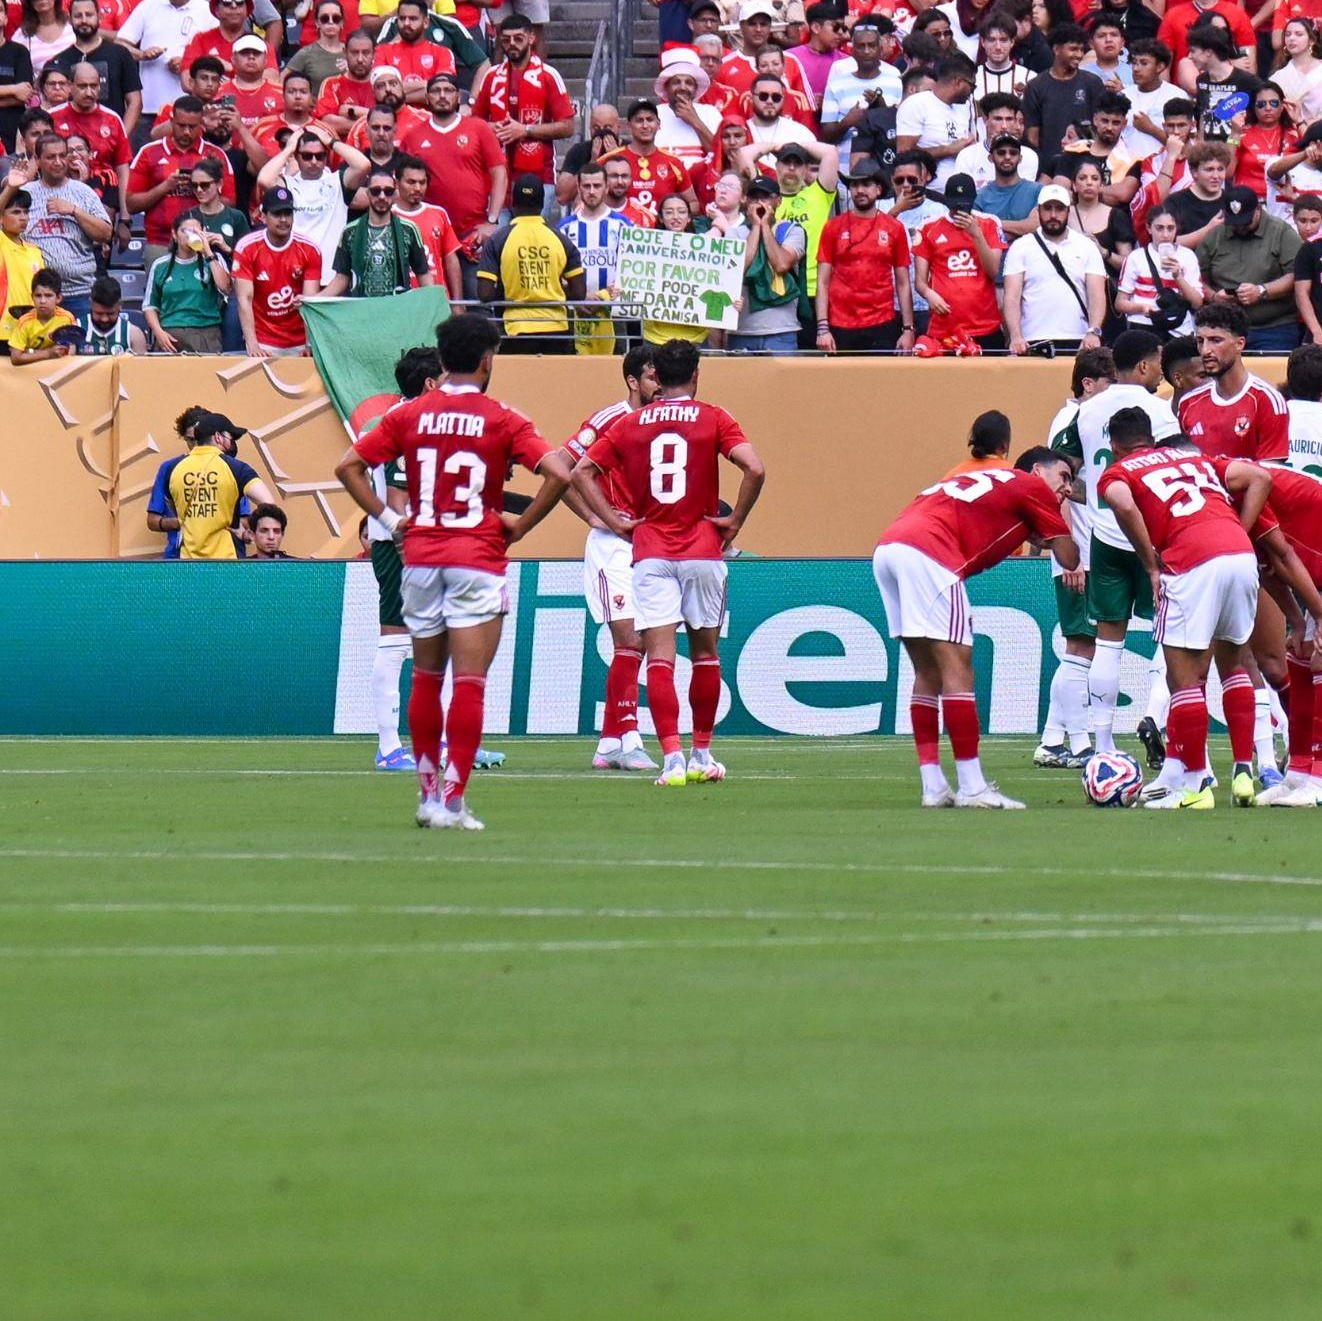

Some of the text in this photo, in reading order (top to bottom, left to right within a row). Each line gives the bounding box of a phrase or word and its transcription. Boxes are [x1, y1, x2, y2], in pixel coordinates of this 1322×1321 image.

[33, 218, 67, 235] AXA
[690, 235, 705, 251] O
[518, 246, 551, 259] CSC
[519, 260, 551, 276] EVENT
[620, 259, 720, 285] POR FAVOR
[520, 276, 550, 290] STAFF
[662, 280, 700, 297] PODE
[643, 292, 680, 310] DAR
[683, 296, 695, 311] A
[638, 405, 700, 426] H.FATHY
[417, 412, 485, 438] M.ATTIA
[649, 433, 689, 505] 8
[183, 471, 218, 486] CSC
[920, 468, 1017, 503] 5
[184, 486, 219, 503] EVENT
[415, 448, 488, 528] 13
[1141, 461, 1232, 518] 54
[185, 503, 218, 519] STAFF
